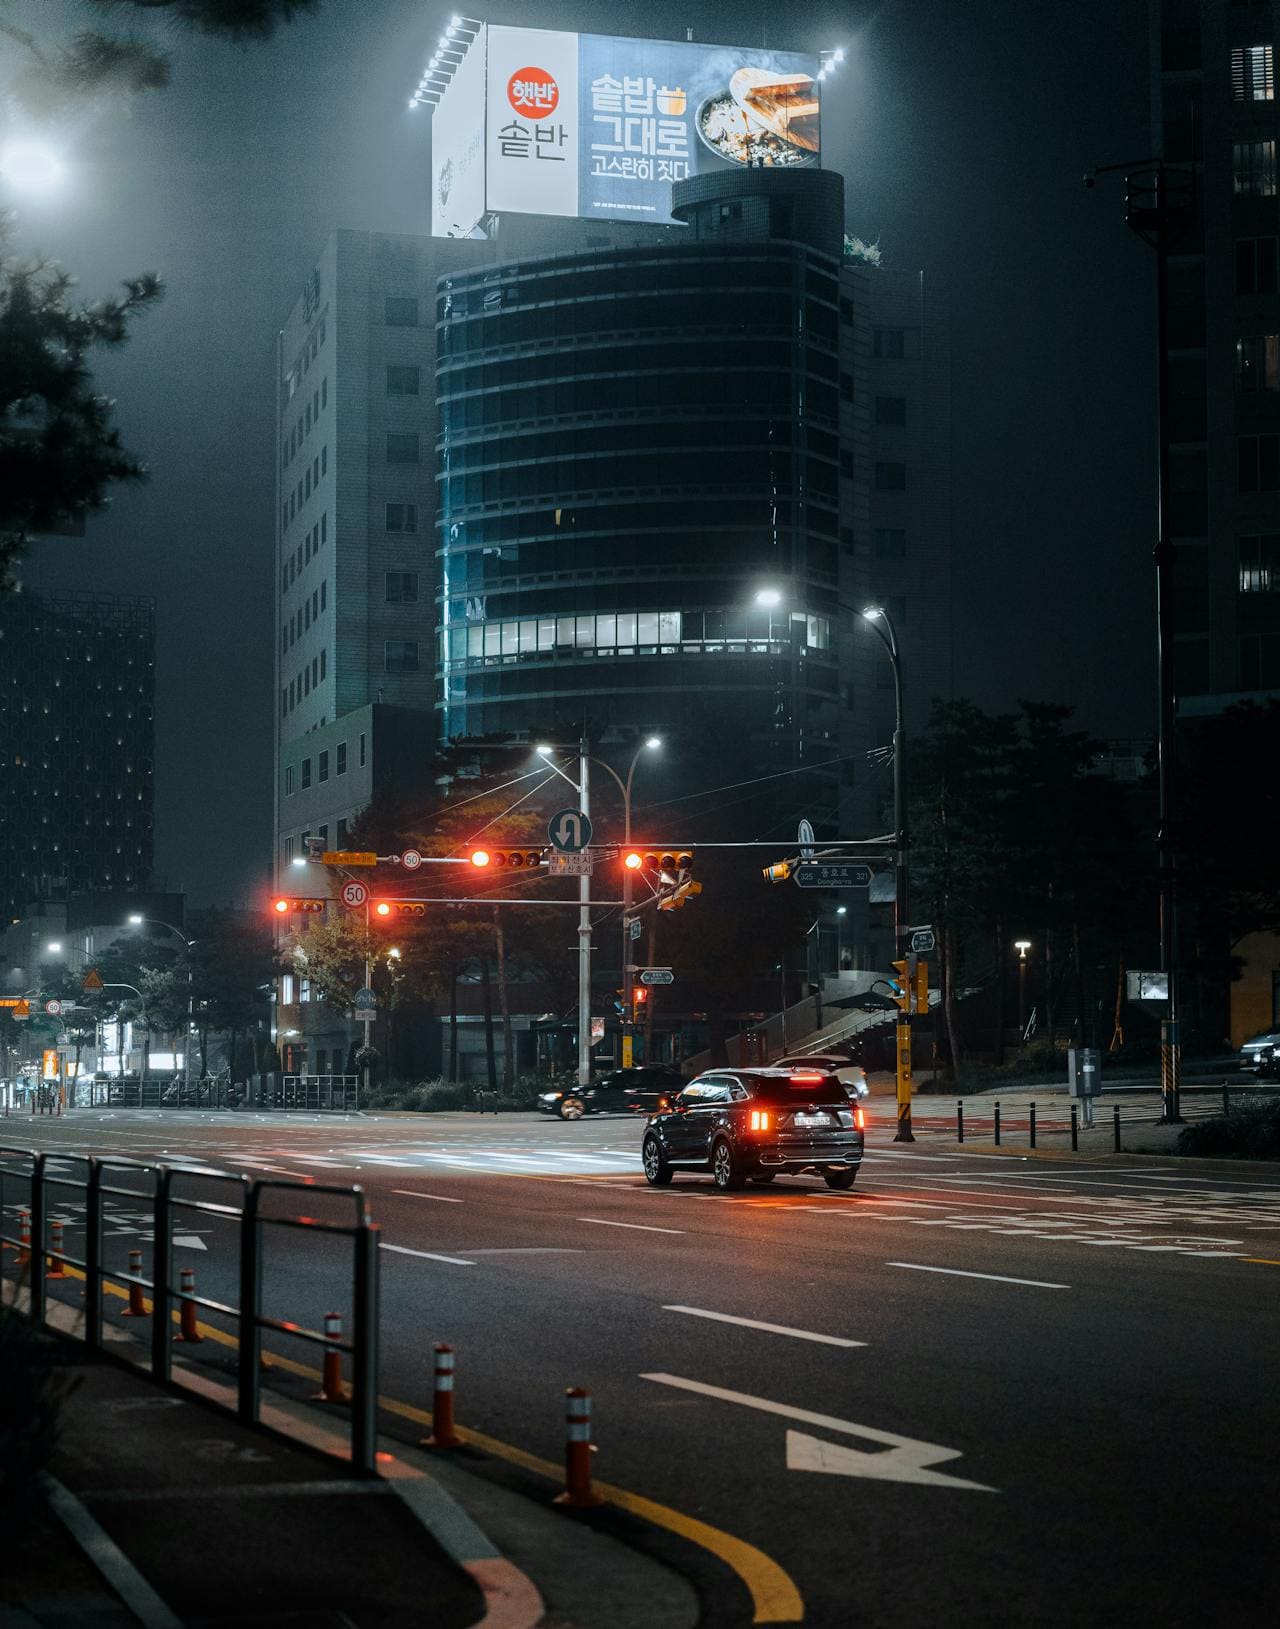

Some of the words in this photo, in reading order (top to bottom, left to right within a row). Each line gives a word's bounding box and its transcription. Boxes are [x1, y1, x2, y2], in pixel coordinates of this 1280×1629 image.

[512, 80, 555, 108] 햇반
[591, 74, 656, 115] 솥밥
[498, 120, 569, 161] 솥반
[591, 115, 689, 157] 그대로
[591, 155, 653, 181] 고스란히
[658, 159, 690, 182] 짓다
[406, 856, 416, 865] 50
[855, 872, 868, 881] 321
[346, 887, 364, 902] 50
